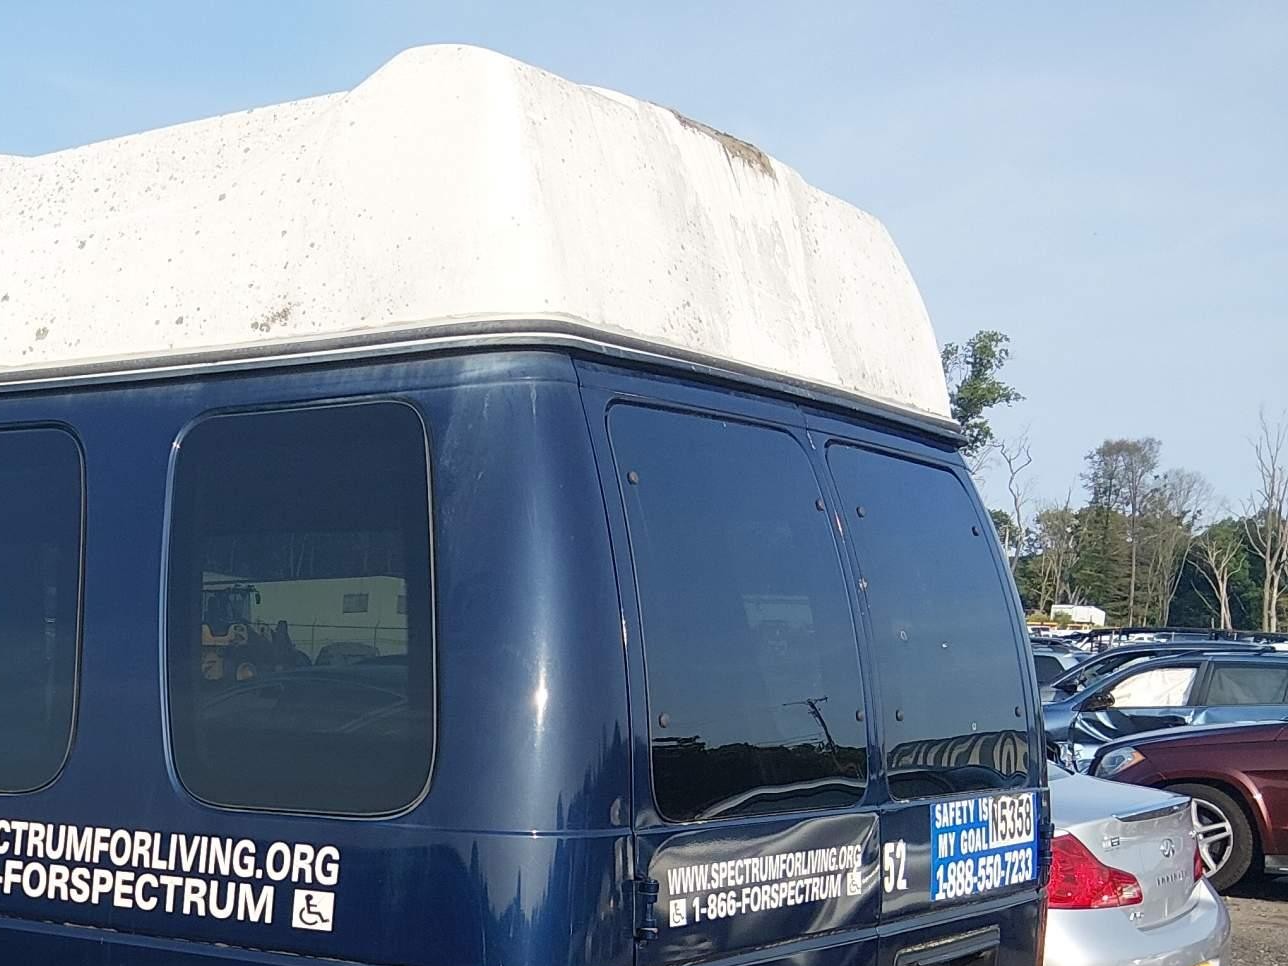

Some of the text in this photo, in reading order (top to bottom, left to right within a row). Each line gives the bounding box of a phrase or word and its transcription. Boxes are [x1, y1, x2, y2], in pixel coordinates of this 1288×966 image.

[935, 798, 989, 829] SAFETY IS
[991, 797, 1032, 843] N5358
[883, 839, 908, 893] 52
[938, 827, 988, 859] MY GOAL
[667, 845, 862, 895] WWW.SPECTRUMFORLIVING.ORG
[935, 848, 1033, 900] 1-888-550-7233
[692, 875, 841, 923] 1-866-FORSPECTRUM
